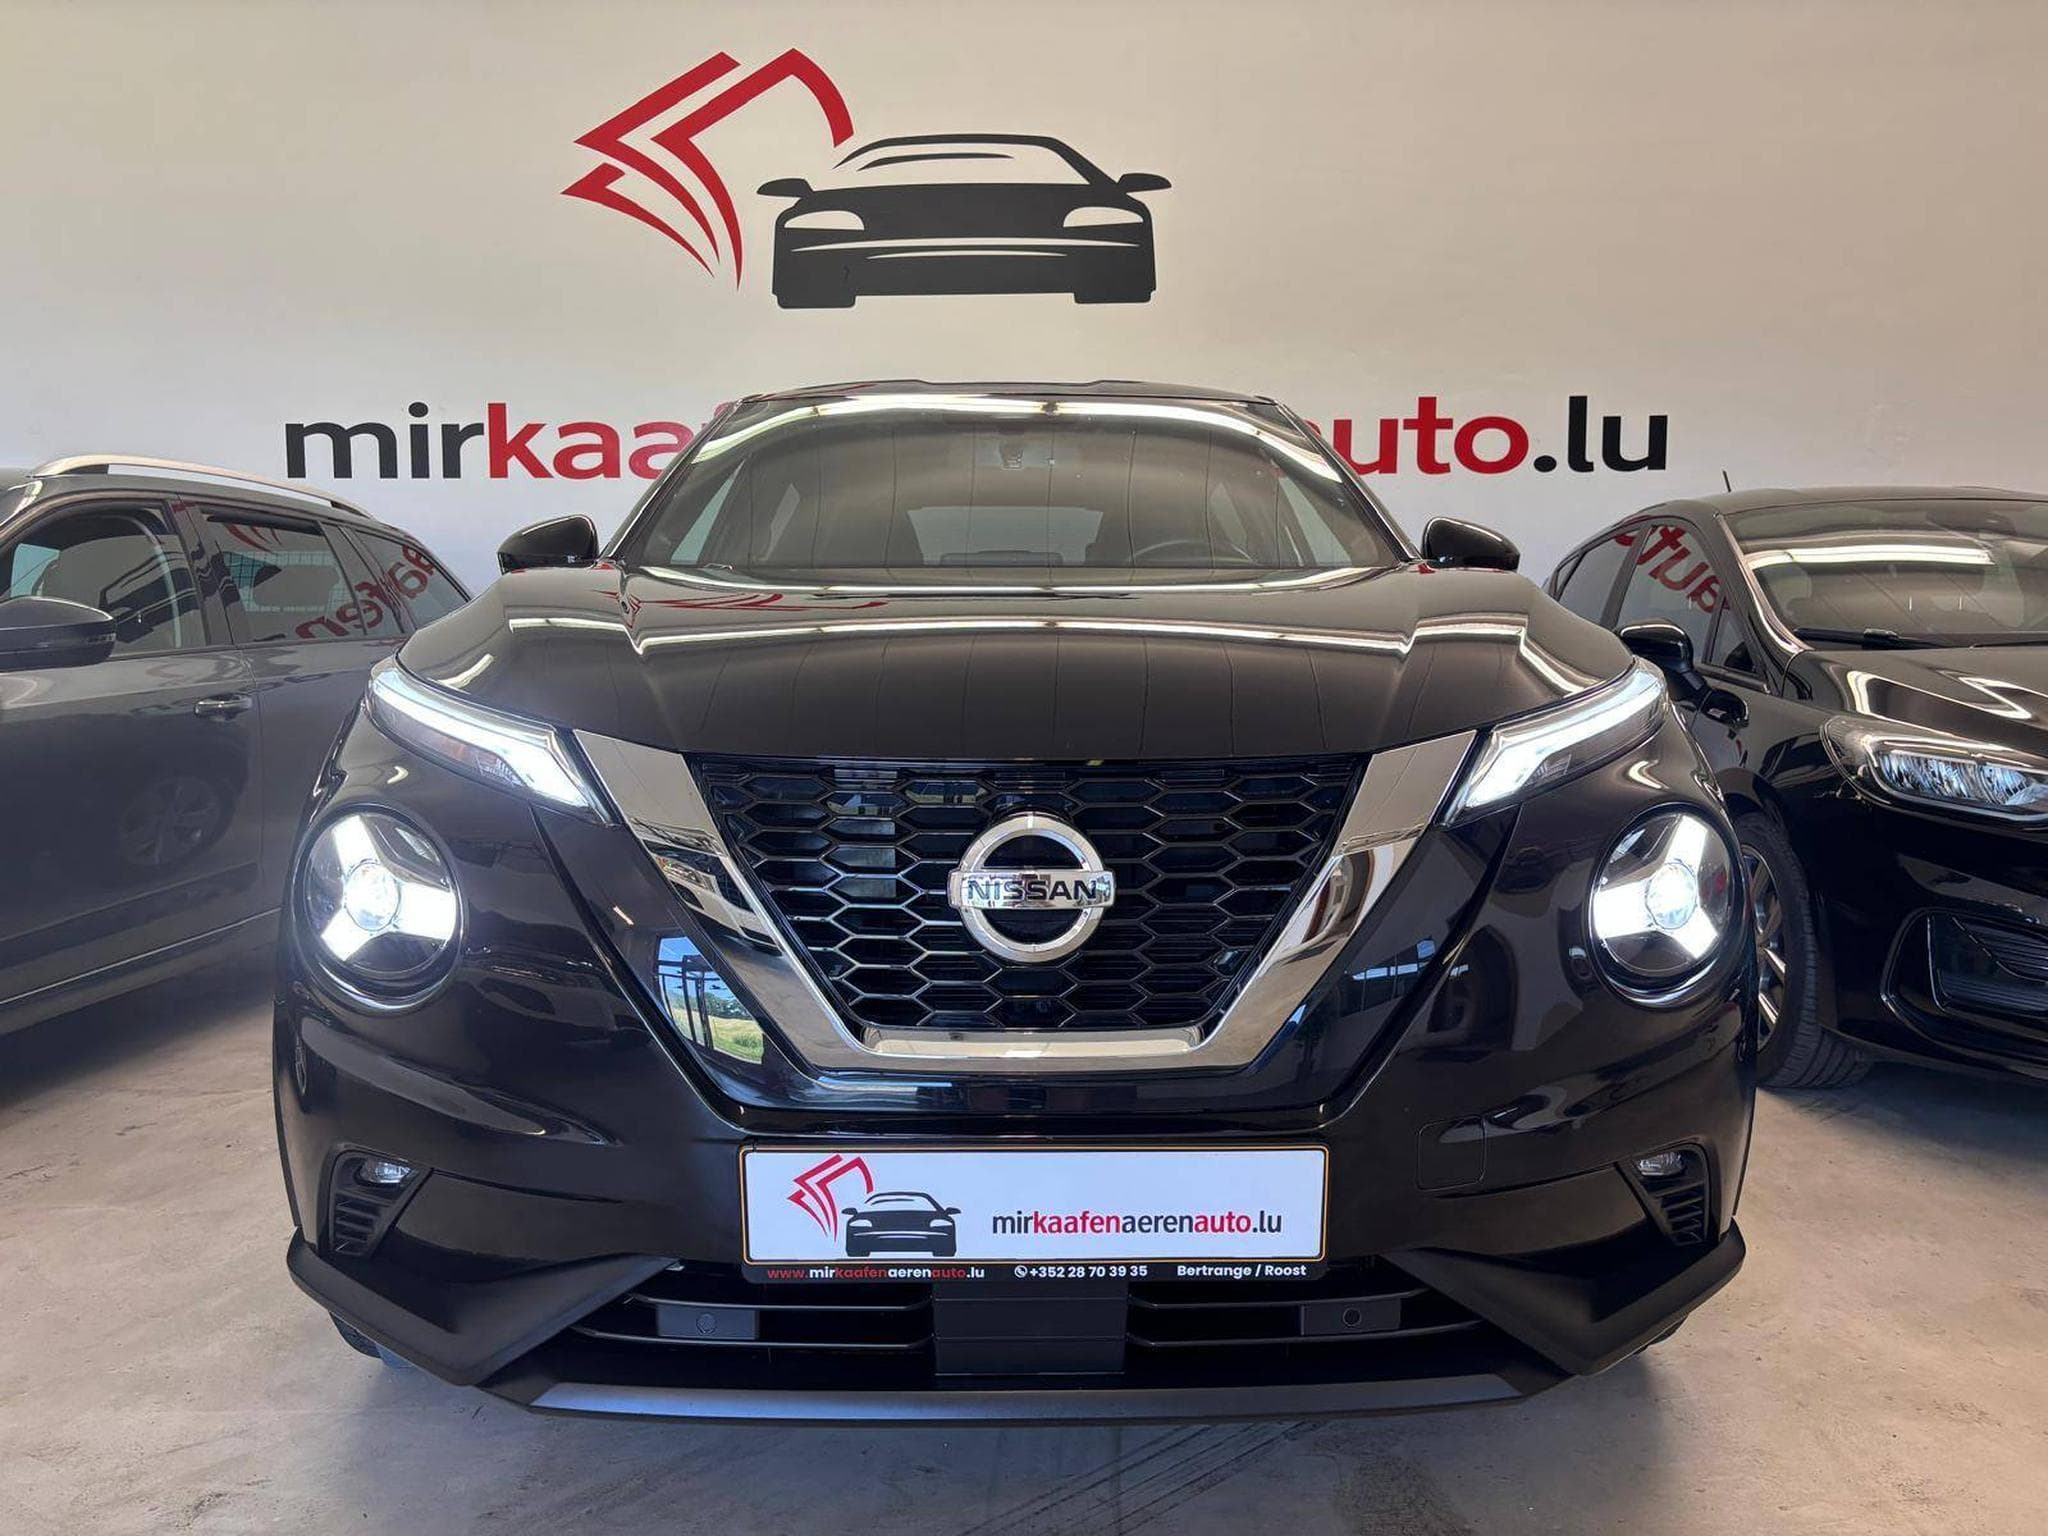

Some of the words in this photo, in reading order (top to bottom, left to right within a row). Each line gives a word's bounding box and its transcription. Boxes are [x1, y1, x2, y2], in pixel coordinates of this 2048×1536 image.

[286, 402, 733, 479] mirkaa
[1303, 396, 1668, 475] uto.lu
[967, 879, 1097, 901] NISSAN
[992, 1210, 1282, 1235] mirkaafenaerenauto.lu
[767, 1265, 985, 1279] www.mirkaafenaerenauto.lu
[1030, 1265, 1065, 1278] +352
[1067, 1265, 1085, 1278] 28
[1088, 1265, 1105, 1277] 70
[1109, 1265, 1126, 1277] 39
[1129, 1265, 1148, 1277] 35
[1177, 1265, 1252, 1279] Bertrange
[1265, 1265, 1307, 1277] Roost
